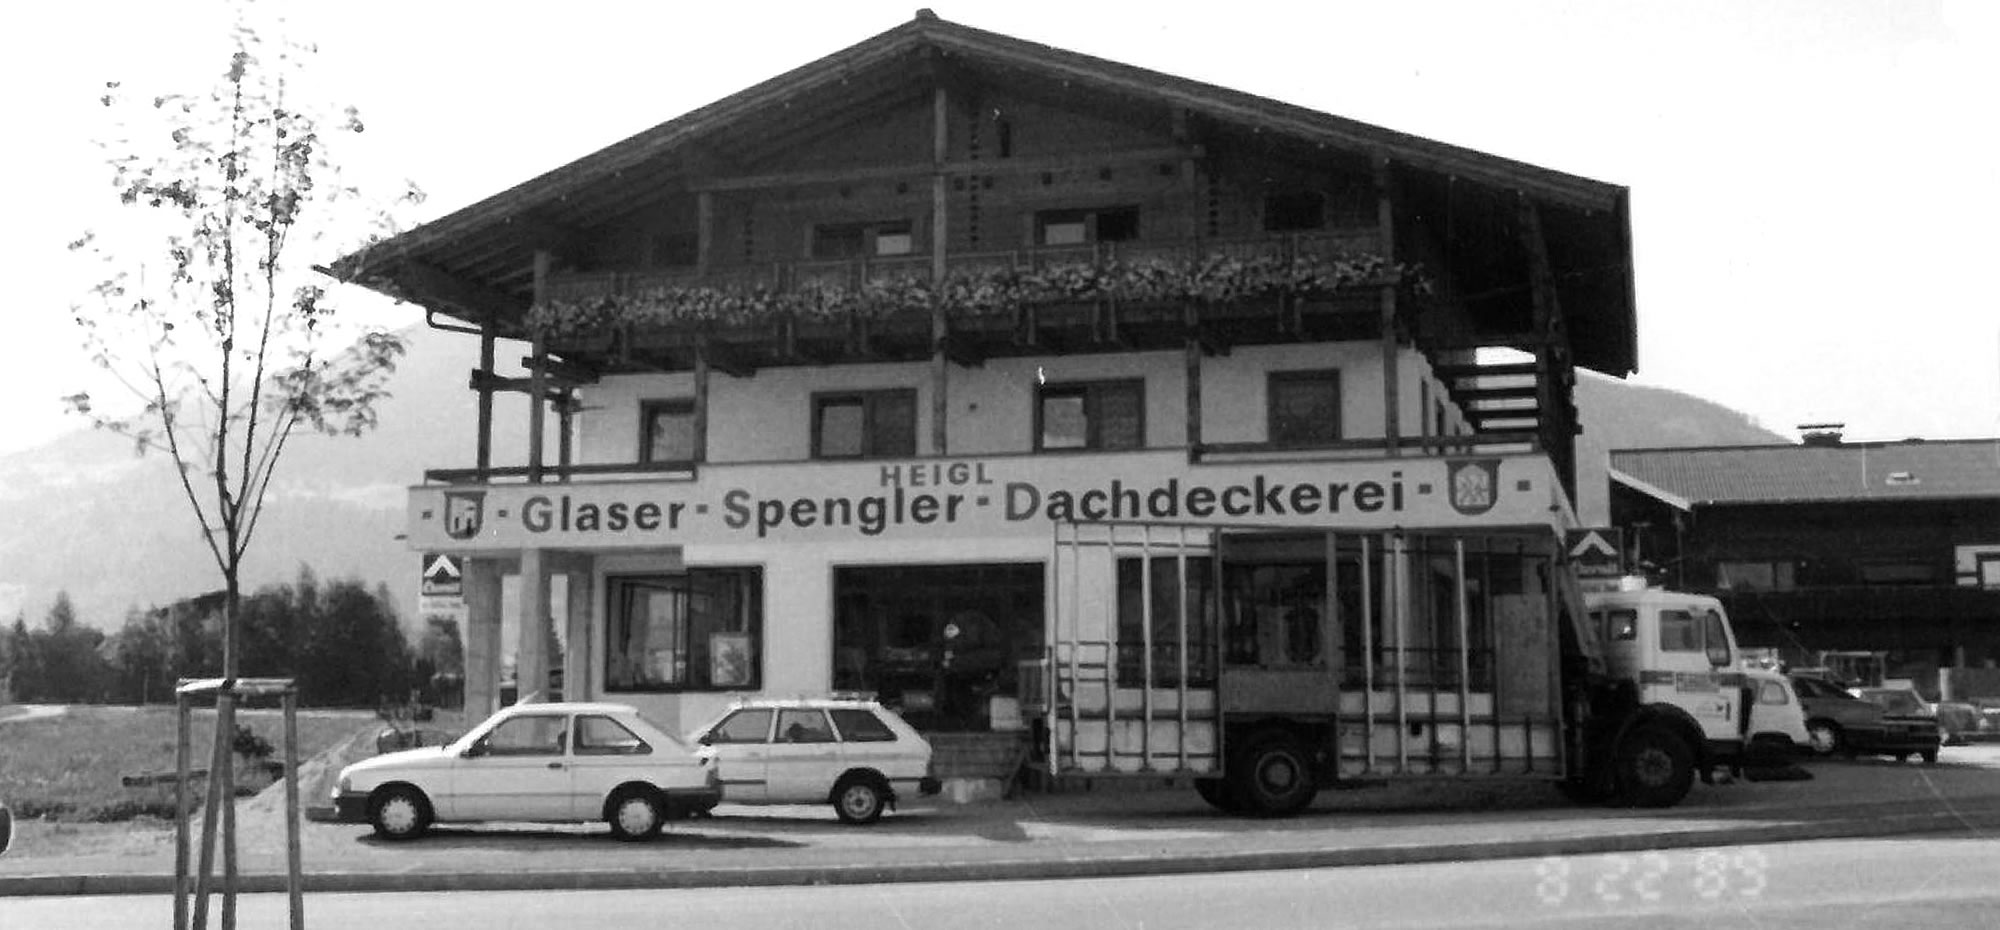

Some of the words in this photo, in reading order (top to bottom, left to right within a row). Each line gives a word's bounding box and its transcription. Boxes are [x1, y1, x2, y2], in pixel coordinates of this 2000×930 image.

[880, 463, 993, 487] HEIGL
[521, 495, 686, 533] Glaser
[723, 488, 965, 538] Spengler
[1005, 471, 1404, 522] Dachdeckerei
